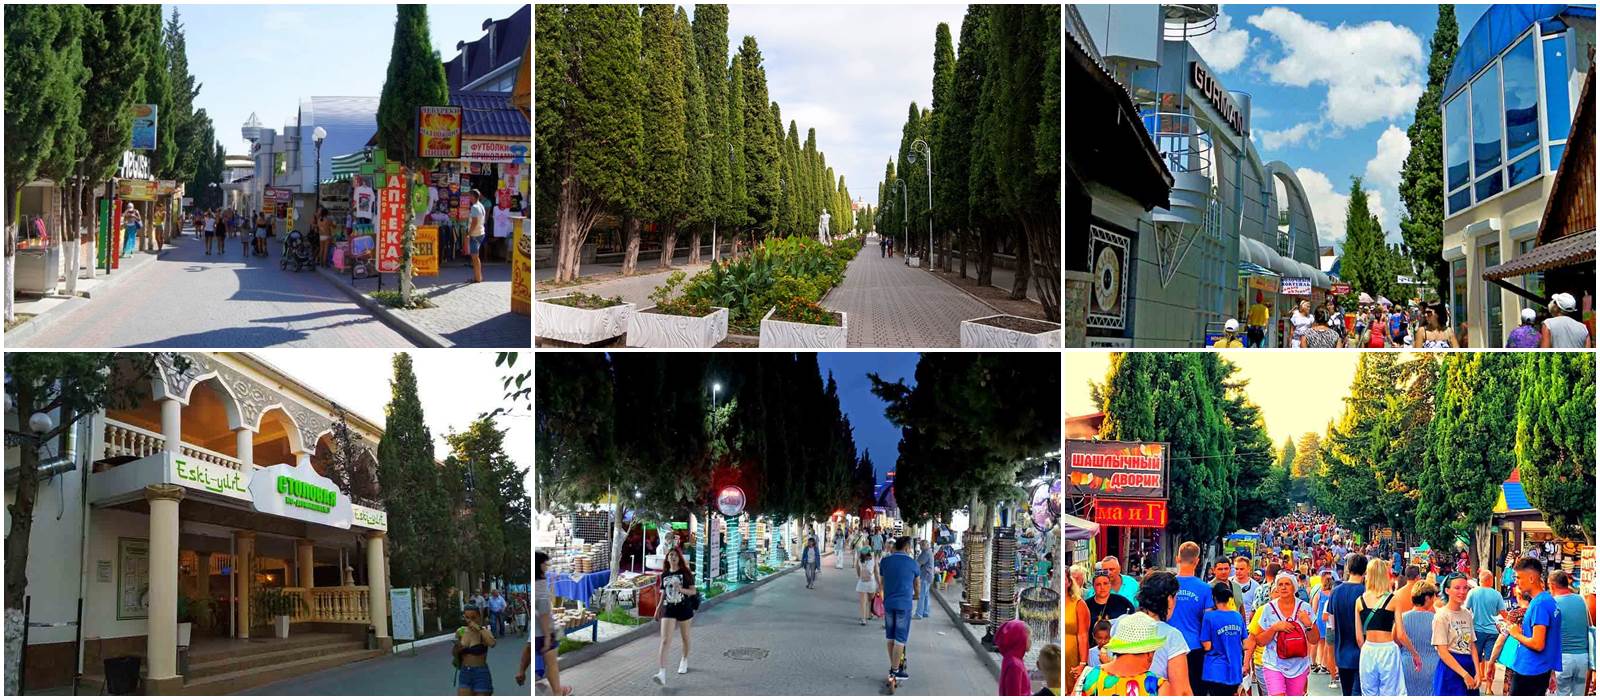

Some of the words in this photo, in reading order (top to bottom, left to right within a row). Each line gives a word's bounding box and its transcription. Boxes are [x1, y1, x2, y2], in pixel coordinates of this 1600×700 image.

[1190, 61, 1244, 136] GURMAN
[386, 175, 401, 258] АПТЕКА
[176, 460, 246, 493] Eski-yurt
[1072, 453, 1162, 471] ШАШЛЫЧНЫЙ
[277, 475, 336, 507] СТОЛОВАЯ
[1110, 472, 1160, 488] ДВОРИК
